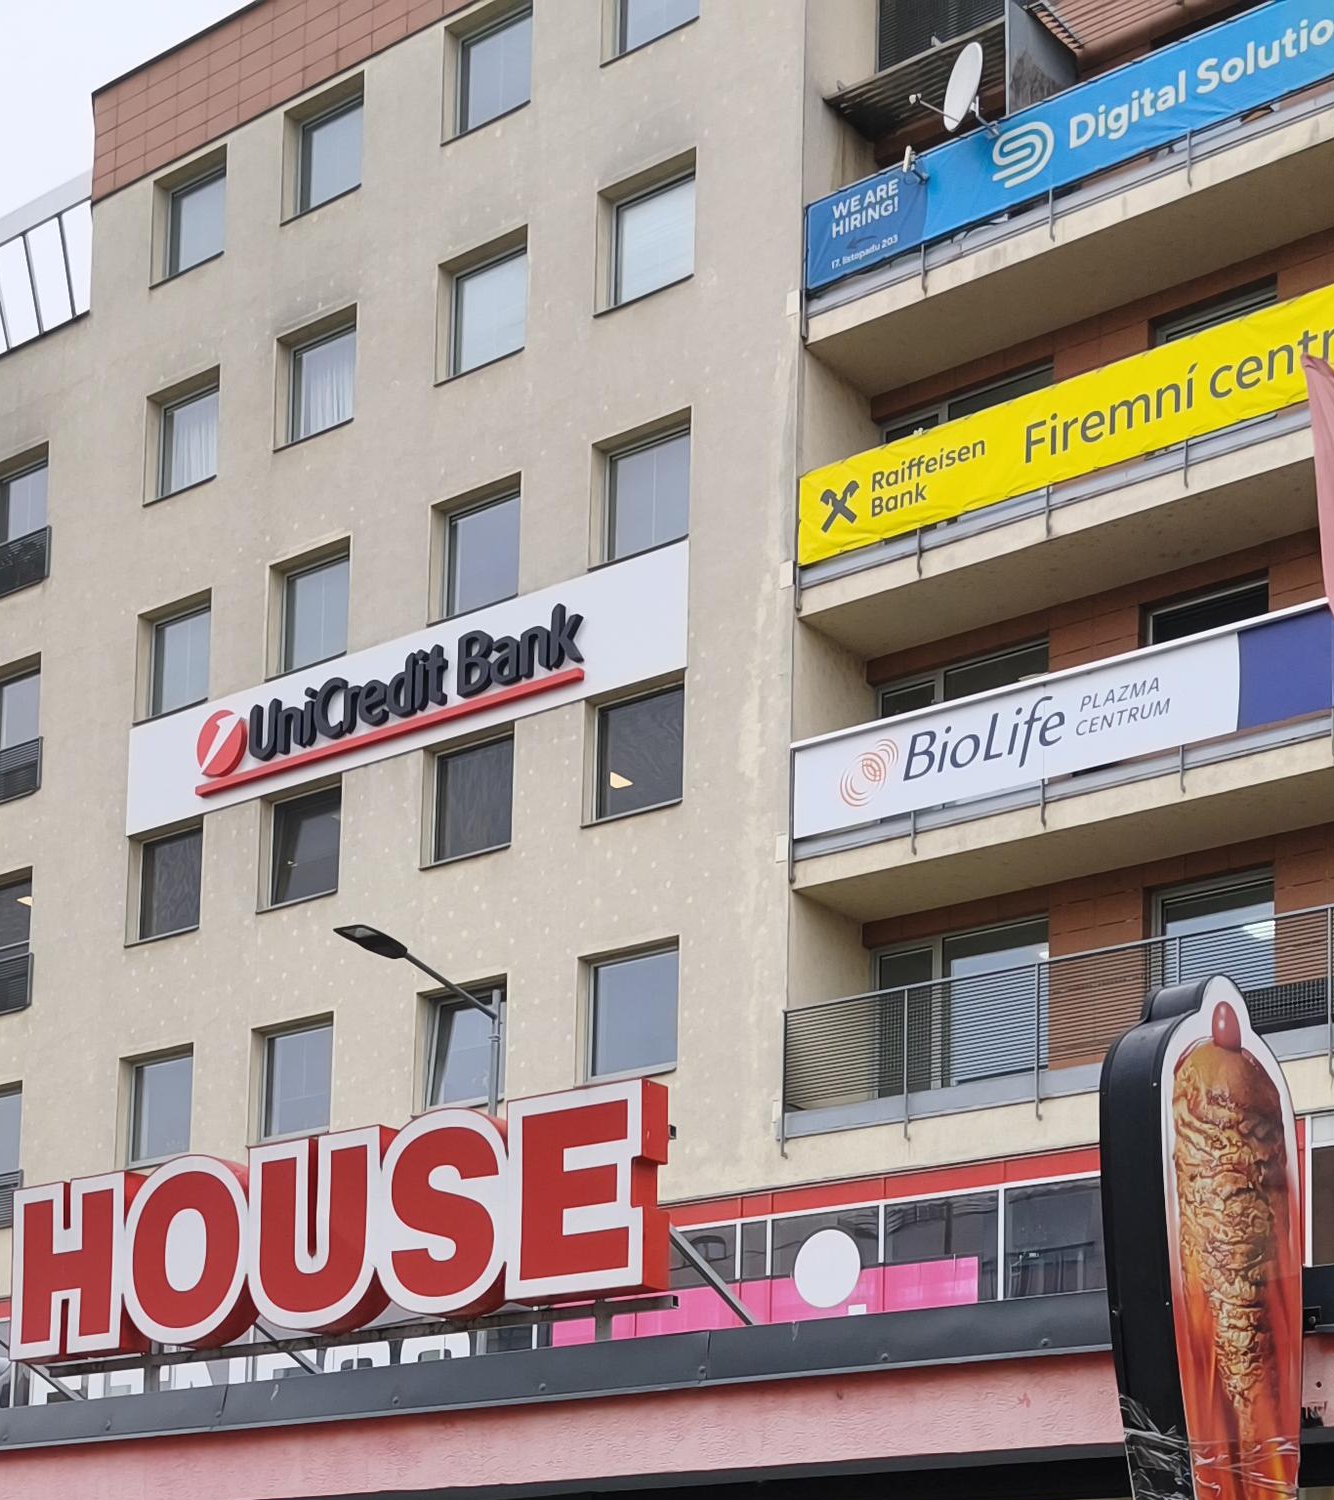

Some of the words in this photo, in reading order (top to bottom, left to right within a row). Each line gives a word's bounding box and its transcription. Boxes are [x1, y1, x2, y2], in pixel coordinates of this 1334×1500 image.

[1069, 68, 1186, 150] Digital
[831, 195, 899, 239] HIRING!
[832, 194, 861, 219] WE
[863, 178, 899, 207] ARE
[842, 242, 881, 266] listopadu
[1024, 354, 1198, 465] Firemní
[870, 435, 987, 492] Raiffeisen
[870, 484, 929, 519] Bank
[249, 643, 448, 762] UniCredit
[456, 603, 585, 699] Bank
[1079, 676, 1161, 713] PLAZMA
[902, 695, 1066, 782] BioLife
[1074, 697, 1171, 738] CENTRUM
[8, 1078, 647, 1361] HOUSE
